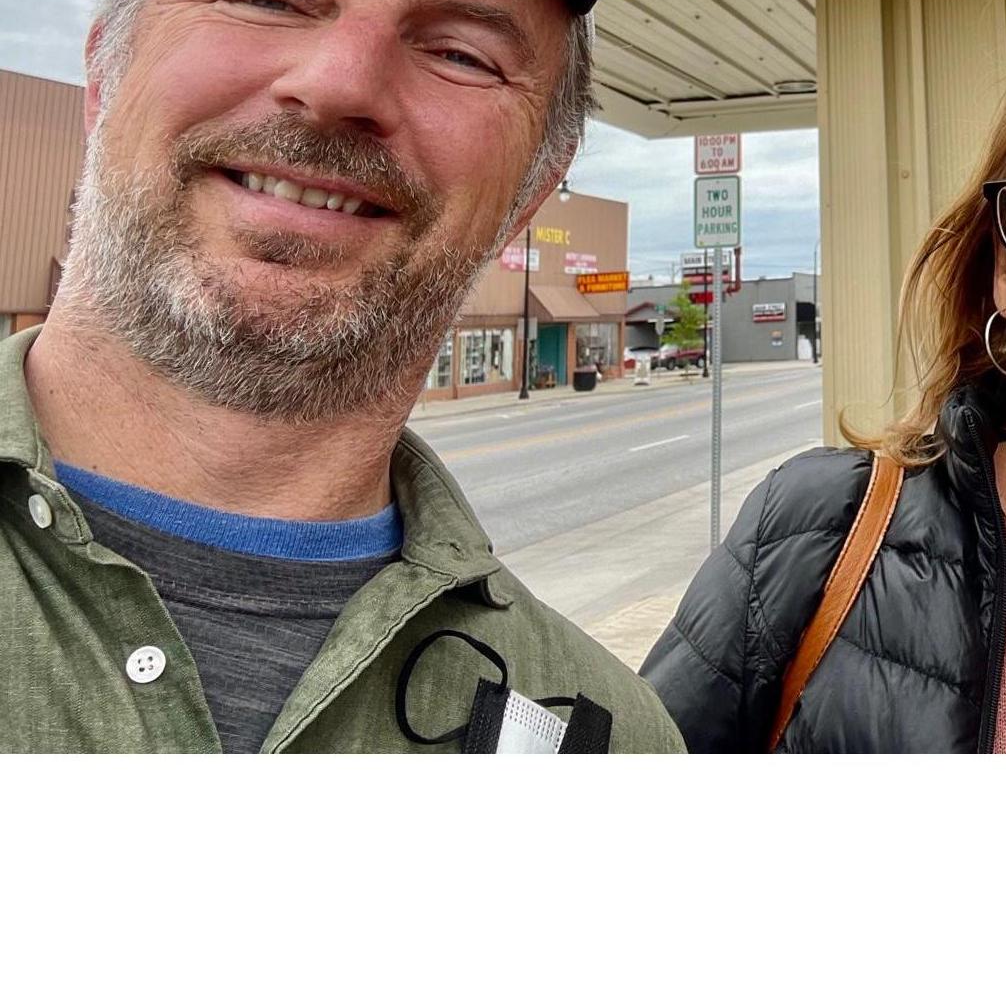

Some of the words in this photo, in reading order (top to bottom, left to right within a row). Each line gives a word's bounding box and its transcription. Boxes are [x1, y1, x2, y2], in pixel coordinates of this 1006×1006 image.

[711, 147, 724, 157] TO
[722, 158, 735, 167] AM
[707, 189, 729, 201] TWO
[702, 205, 732, 218] HOUR
[697, 222, 738, 235] PARKING
